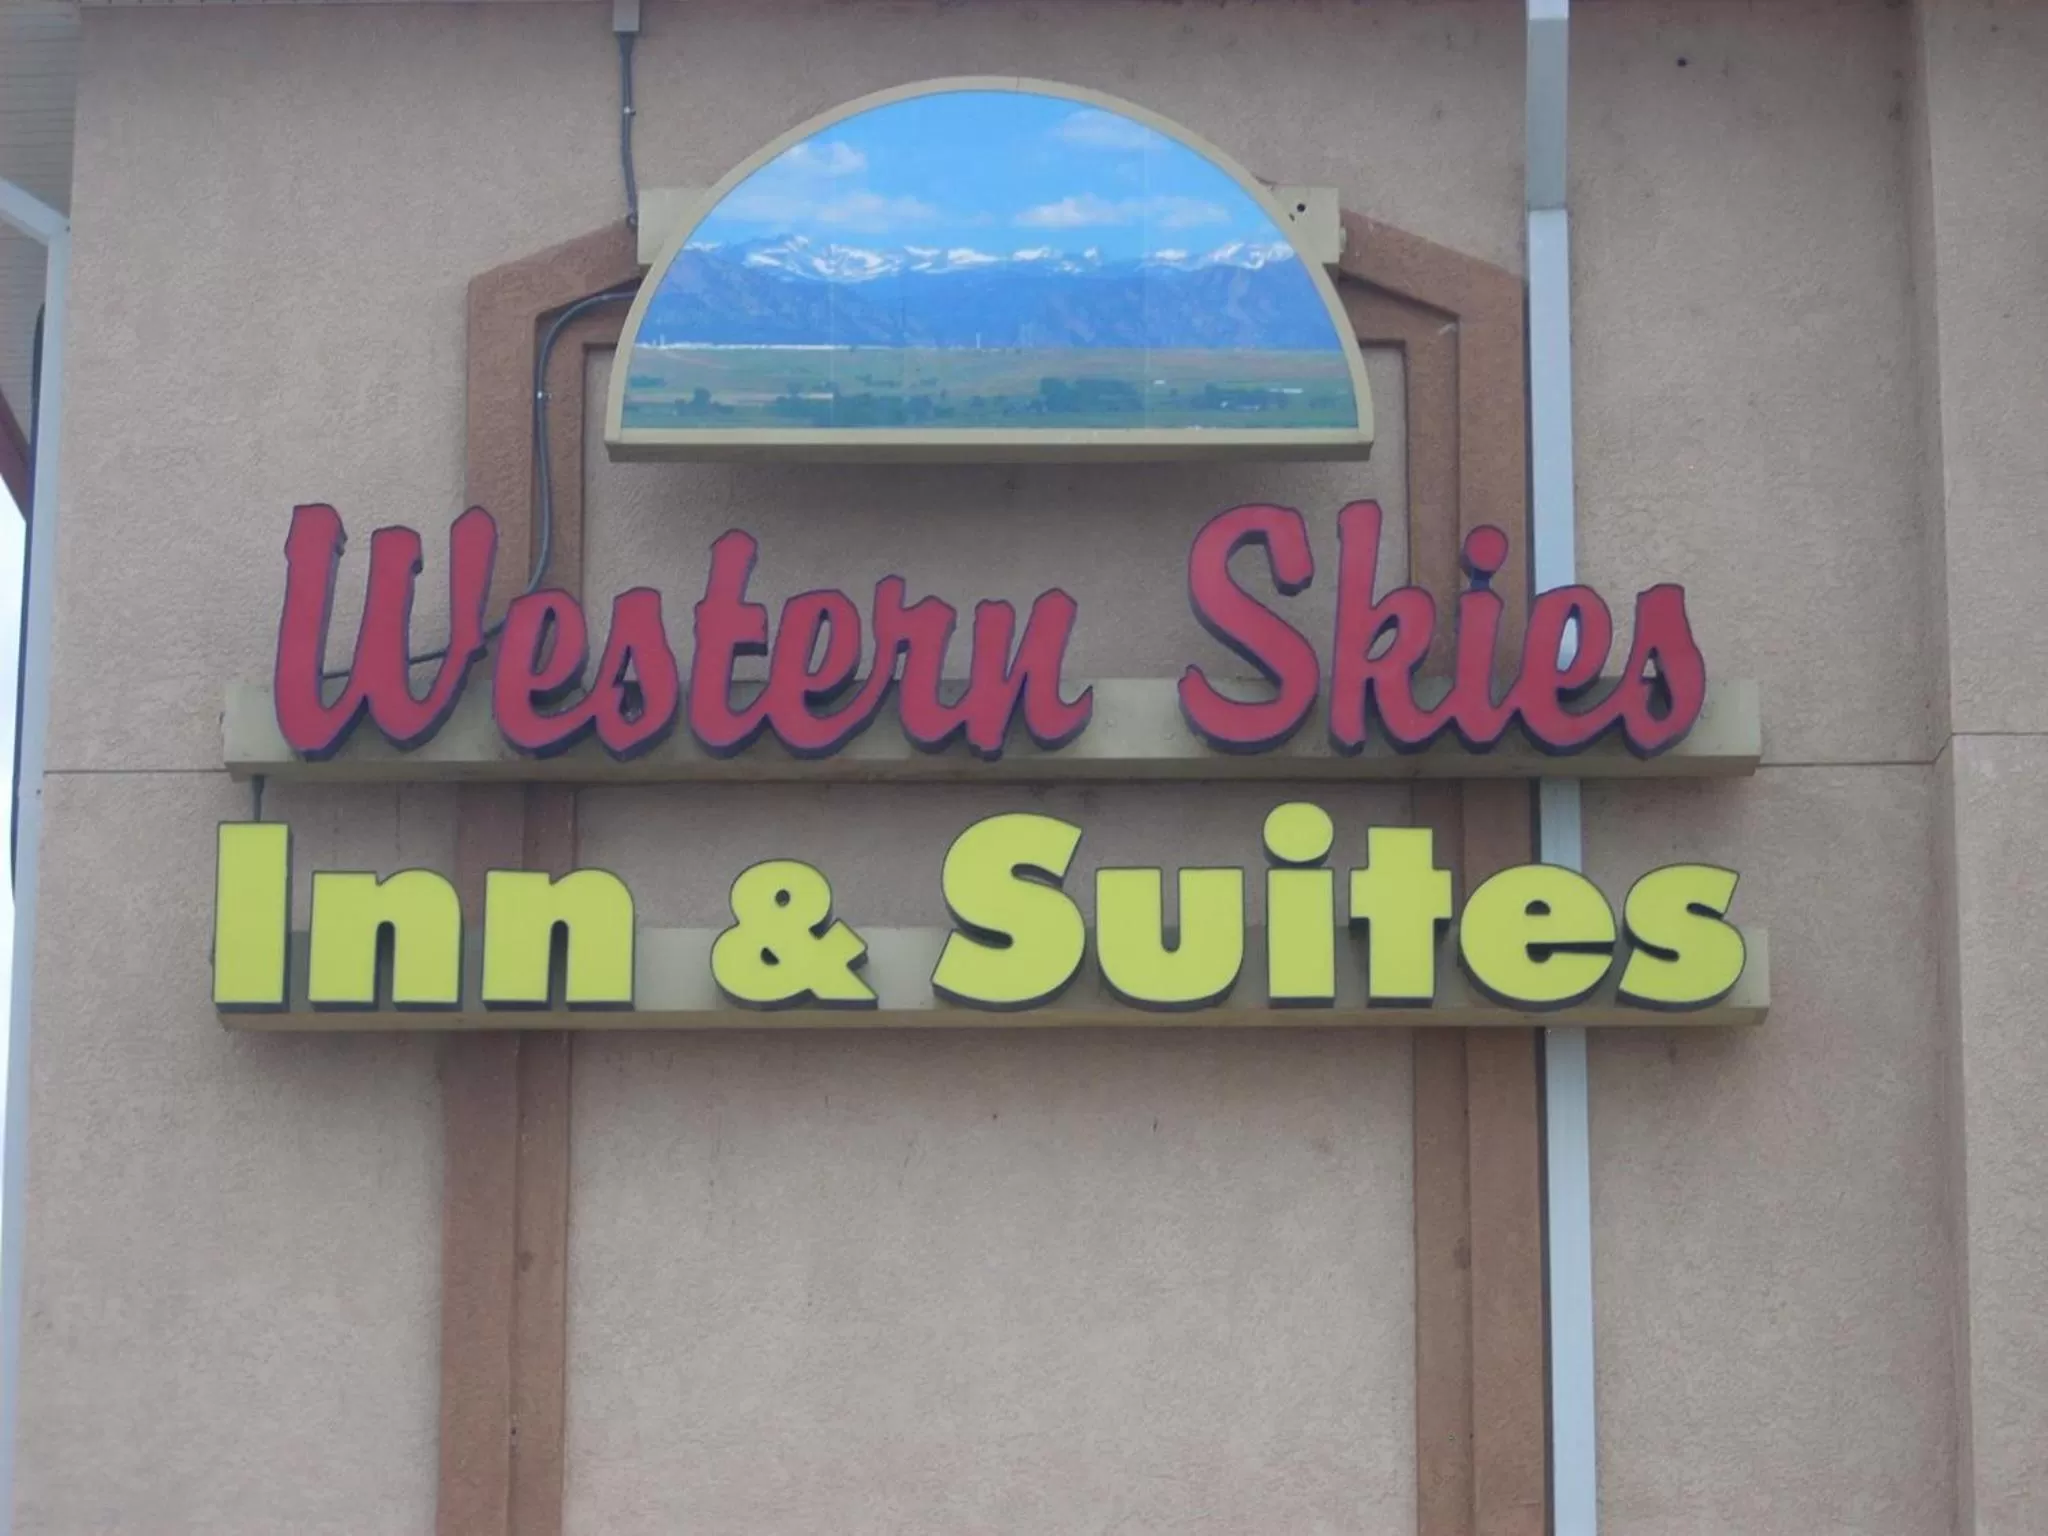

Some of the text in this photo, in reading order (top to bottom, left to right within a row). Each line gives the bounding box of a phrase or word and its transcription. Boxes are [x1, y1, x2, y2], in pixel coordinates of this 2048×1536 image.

[275, 500, 1707, 756] Western Skies
[214, 803, 1747, 1006] Inn & Suites
